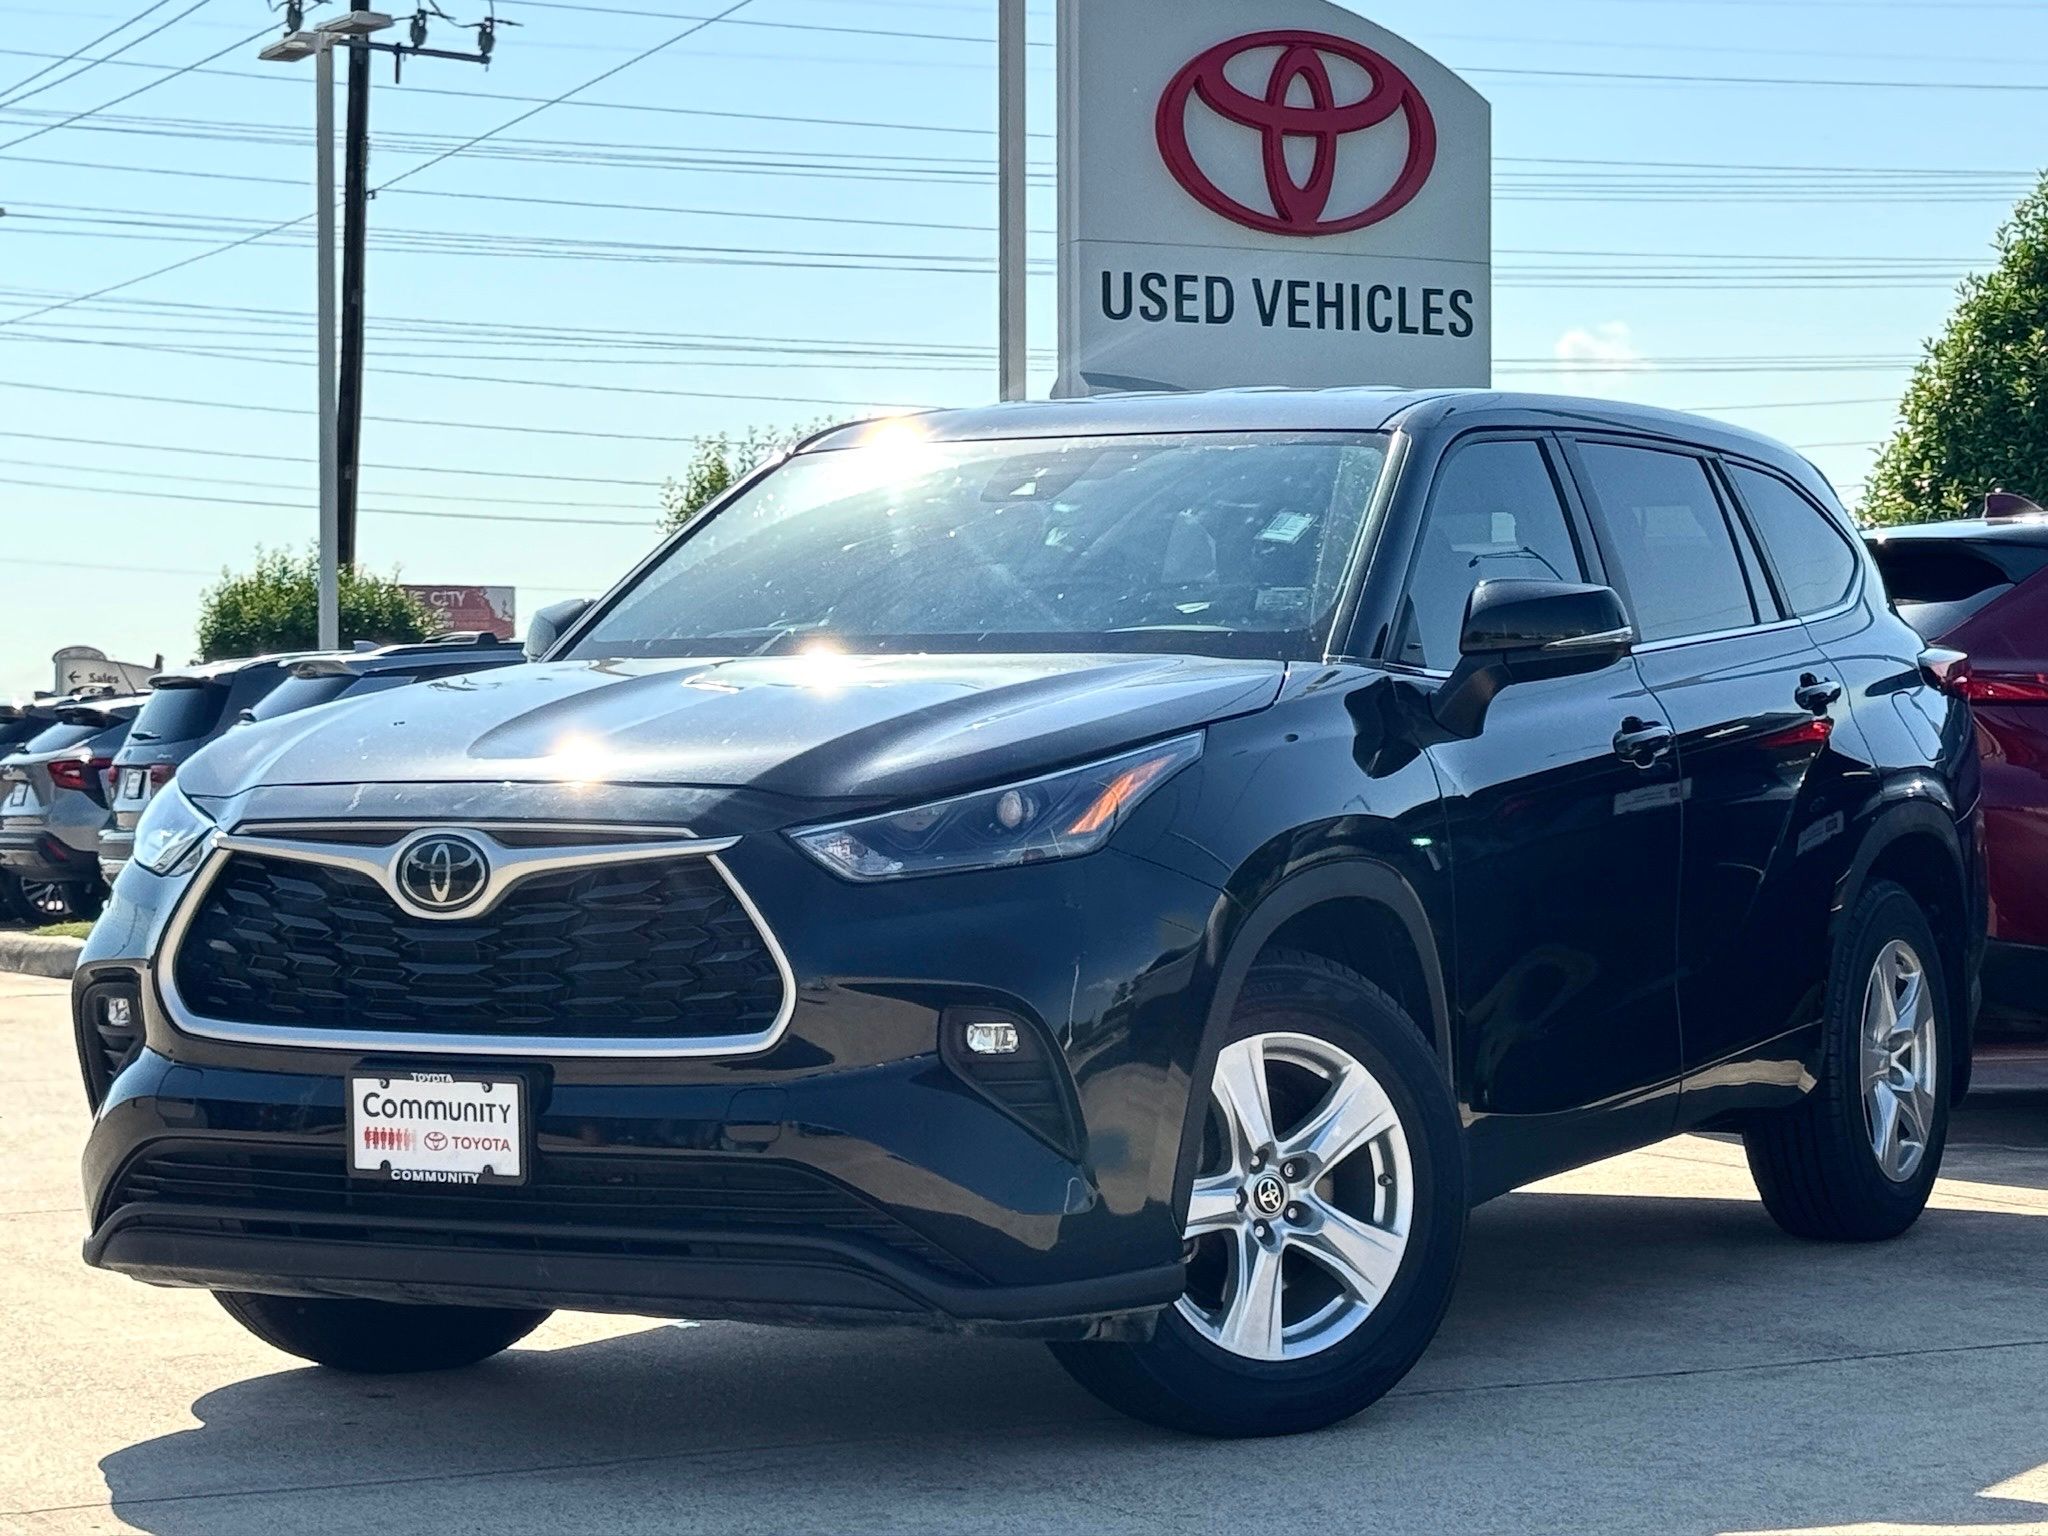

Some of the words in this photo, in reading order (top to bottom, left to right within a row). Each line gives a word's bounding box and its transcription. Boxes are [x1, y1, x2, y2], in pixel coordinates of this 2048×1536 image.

[1101, 271, 1235, 325] USED
[1252, 278, 1474, 338] VEHICLES
[430, 590, 466, 607] CITY
[411, 1072, 454, 1084] TOYOTA
[452, 1136, 512, 1153] TOYOTA
[391, 1169, 480, 1185] COMMUNITY
